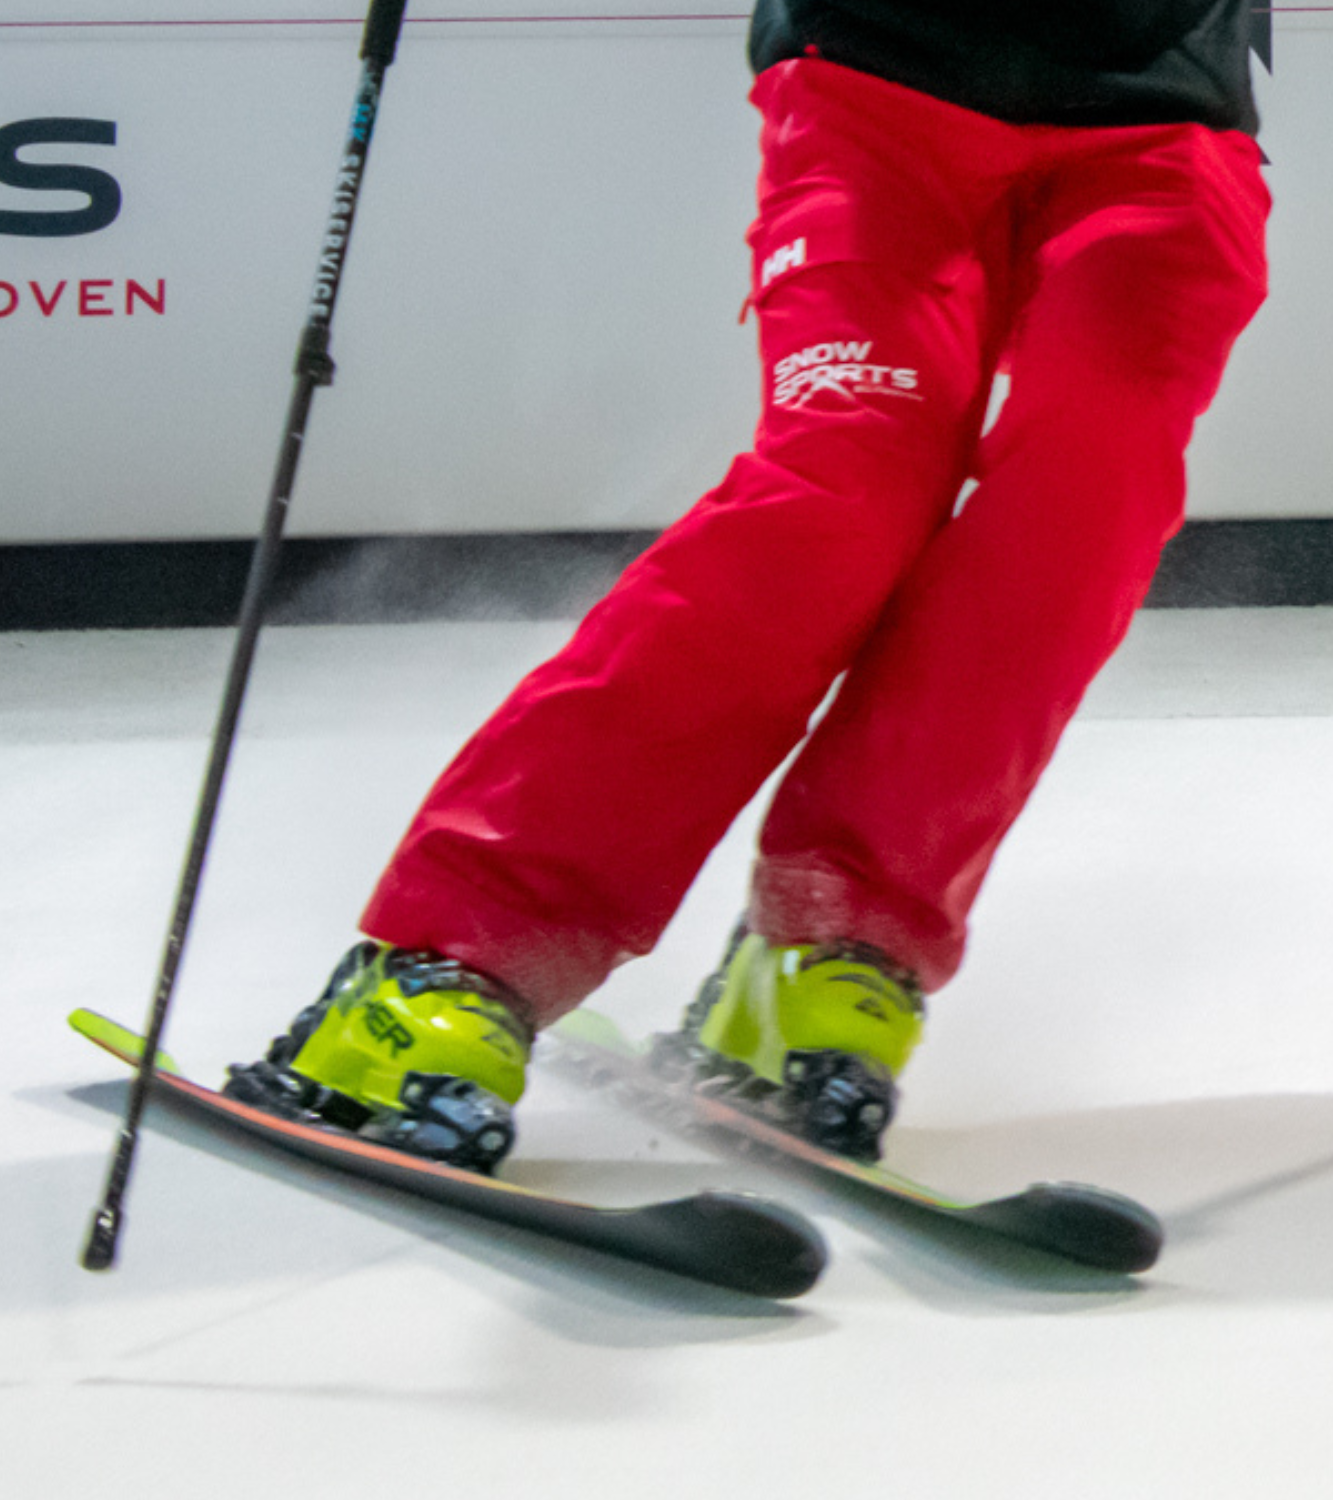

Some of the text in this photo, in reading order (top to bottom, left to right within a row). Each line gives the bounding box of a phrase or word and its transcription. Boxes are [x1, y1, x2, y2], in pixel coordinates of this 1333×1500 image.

[310, 153, 361, 318] SKISERVICE
[773, 341, 873, 383] SNOW
[773, 363, 918, 405] SPORTS
